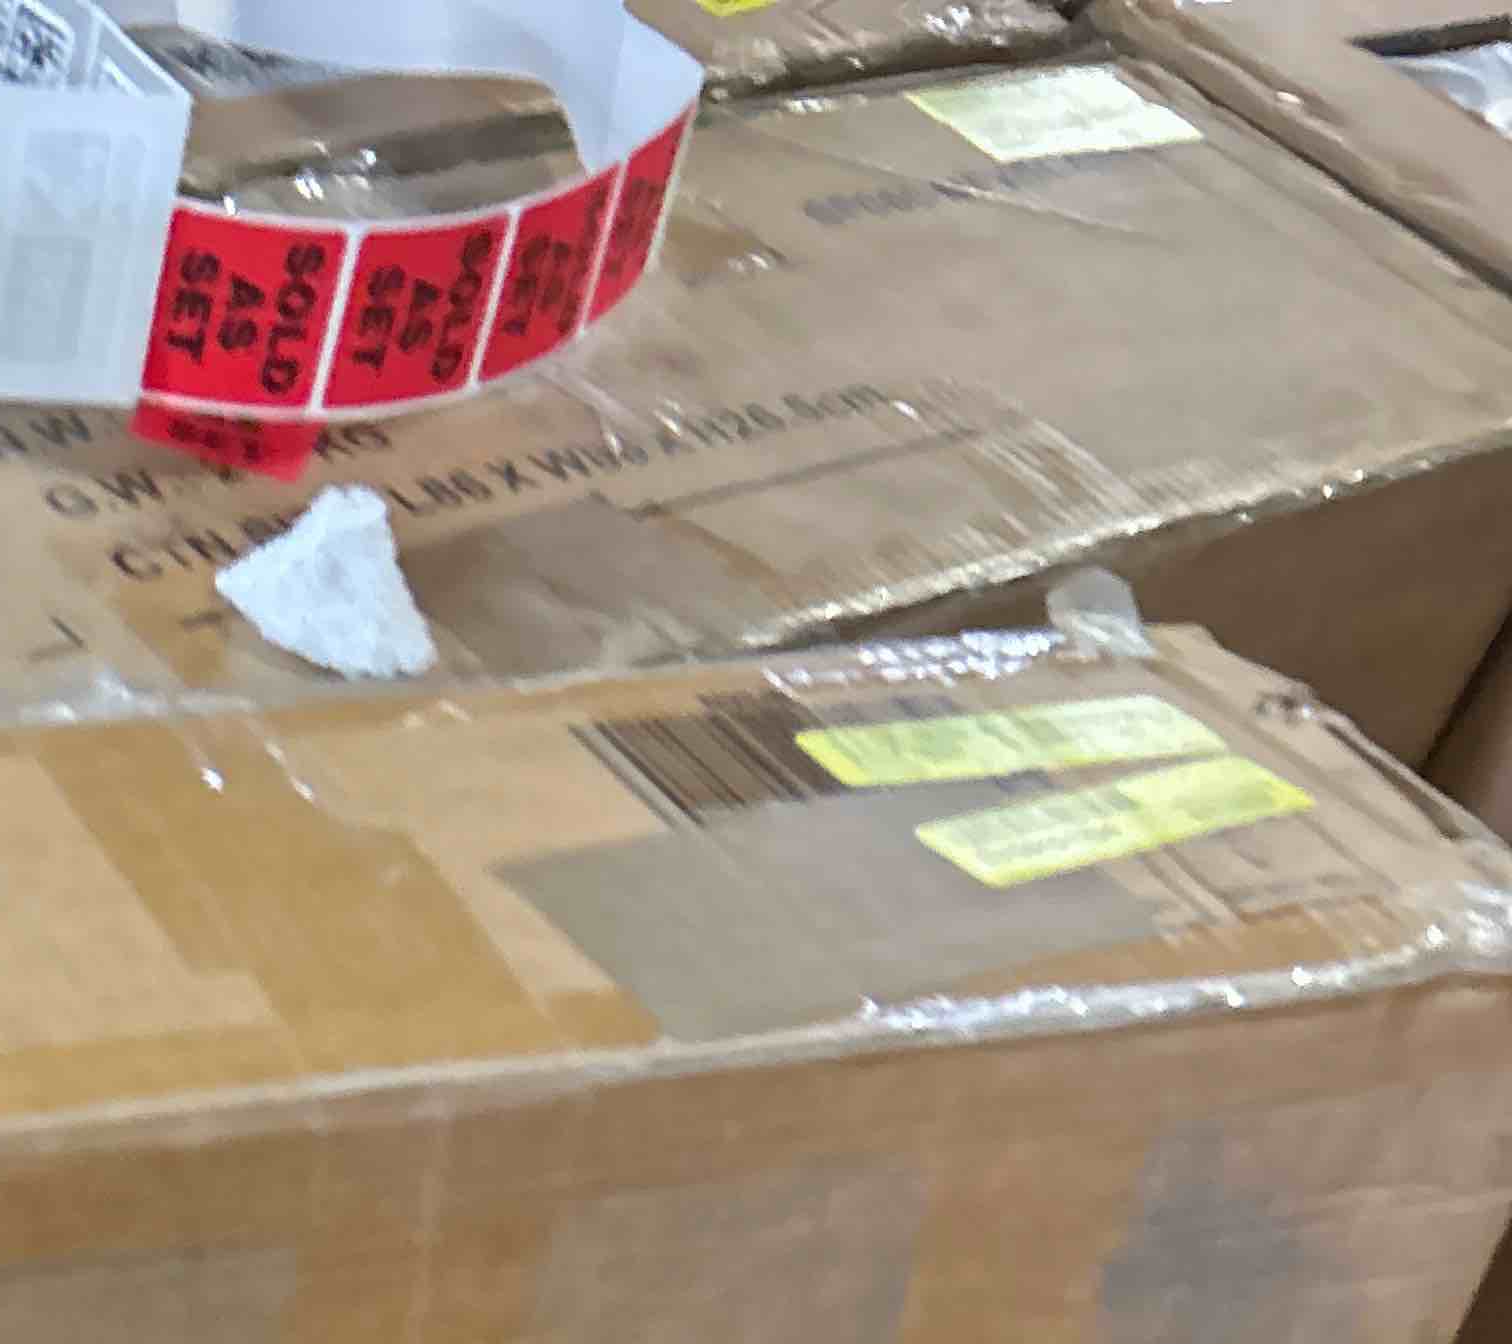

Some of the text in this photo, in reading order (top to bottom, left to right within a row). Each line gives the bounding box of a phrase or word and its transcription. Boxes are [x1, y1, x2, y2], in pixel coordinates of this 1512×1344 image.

[165, 247, 221, 365] SET
[217, 273, 270, 352] AS
[261, 243, 325, 395] SOLD
[354, 265, 405, 376] SET
[396, 278, 441, 352] AS
[431, 232, 491, 382] SOLD
